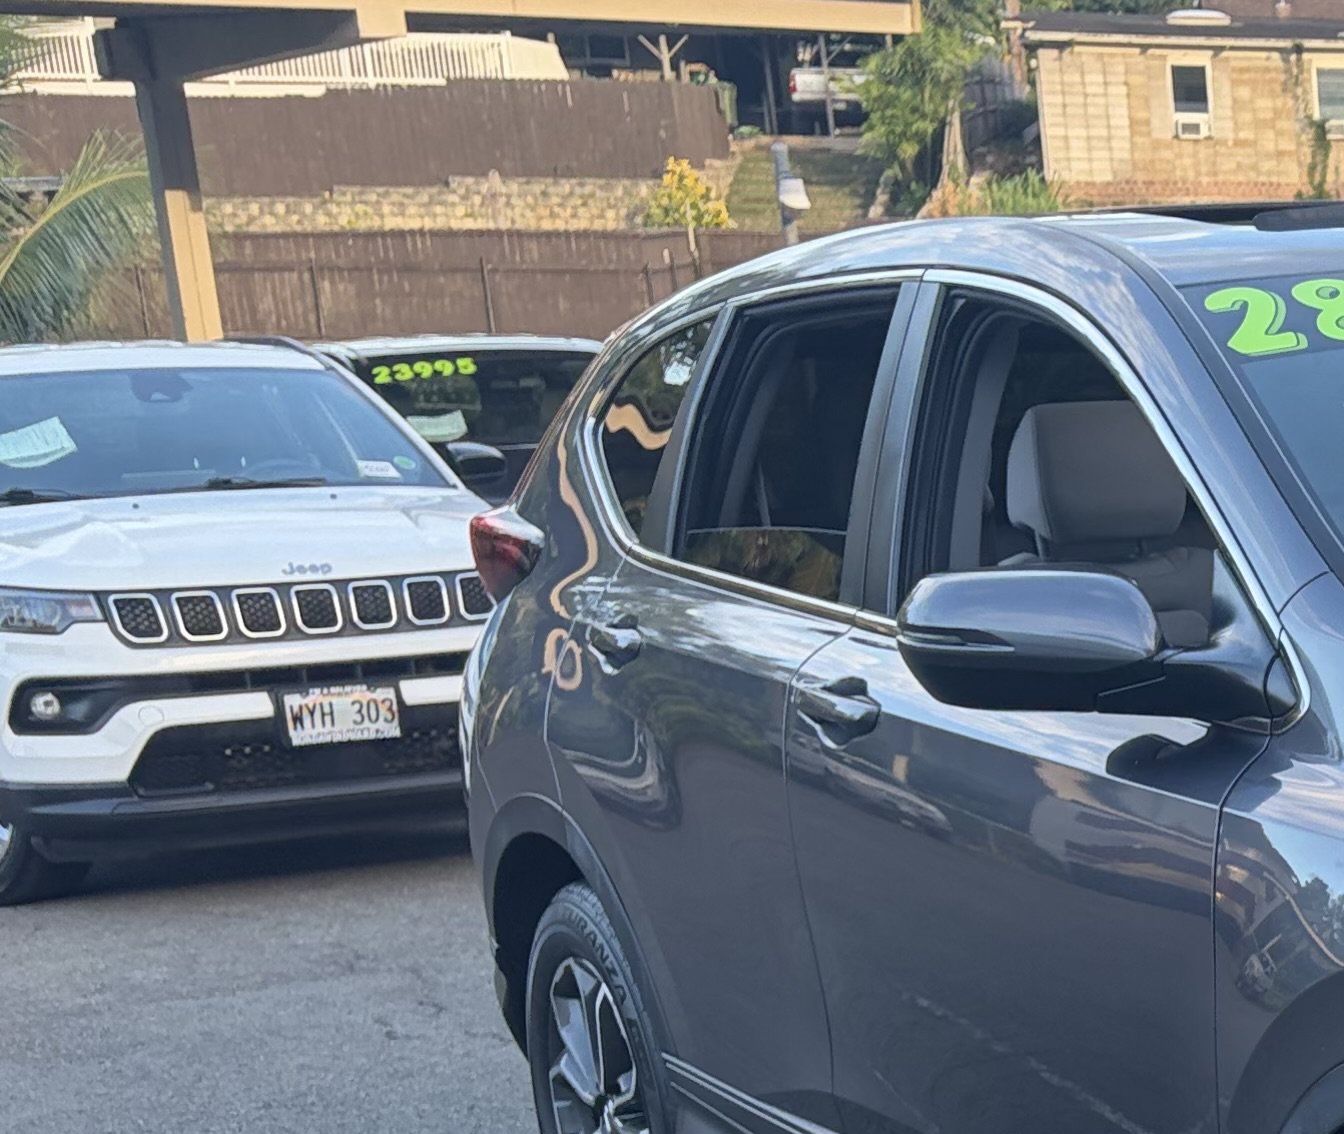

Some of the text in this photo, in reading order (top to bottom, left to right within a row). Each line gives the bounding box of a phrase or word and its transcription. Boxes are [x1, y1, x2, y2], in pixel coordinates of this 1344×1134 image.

[371, 357, 477, 385] 23995
[281, 562, 332, 575] Jeep
[289, 698, 396, 732] WYH 303
